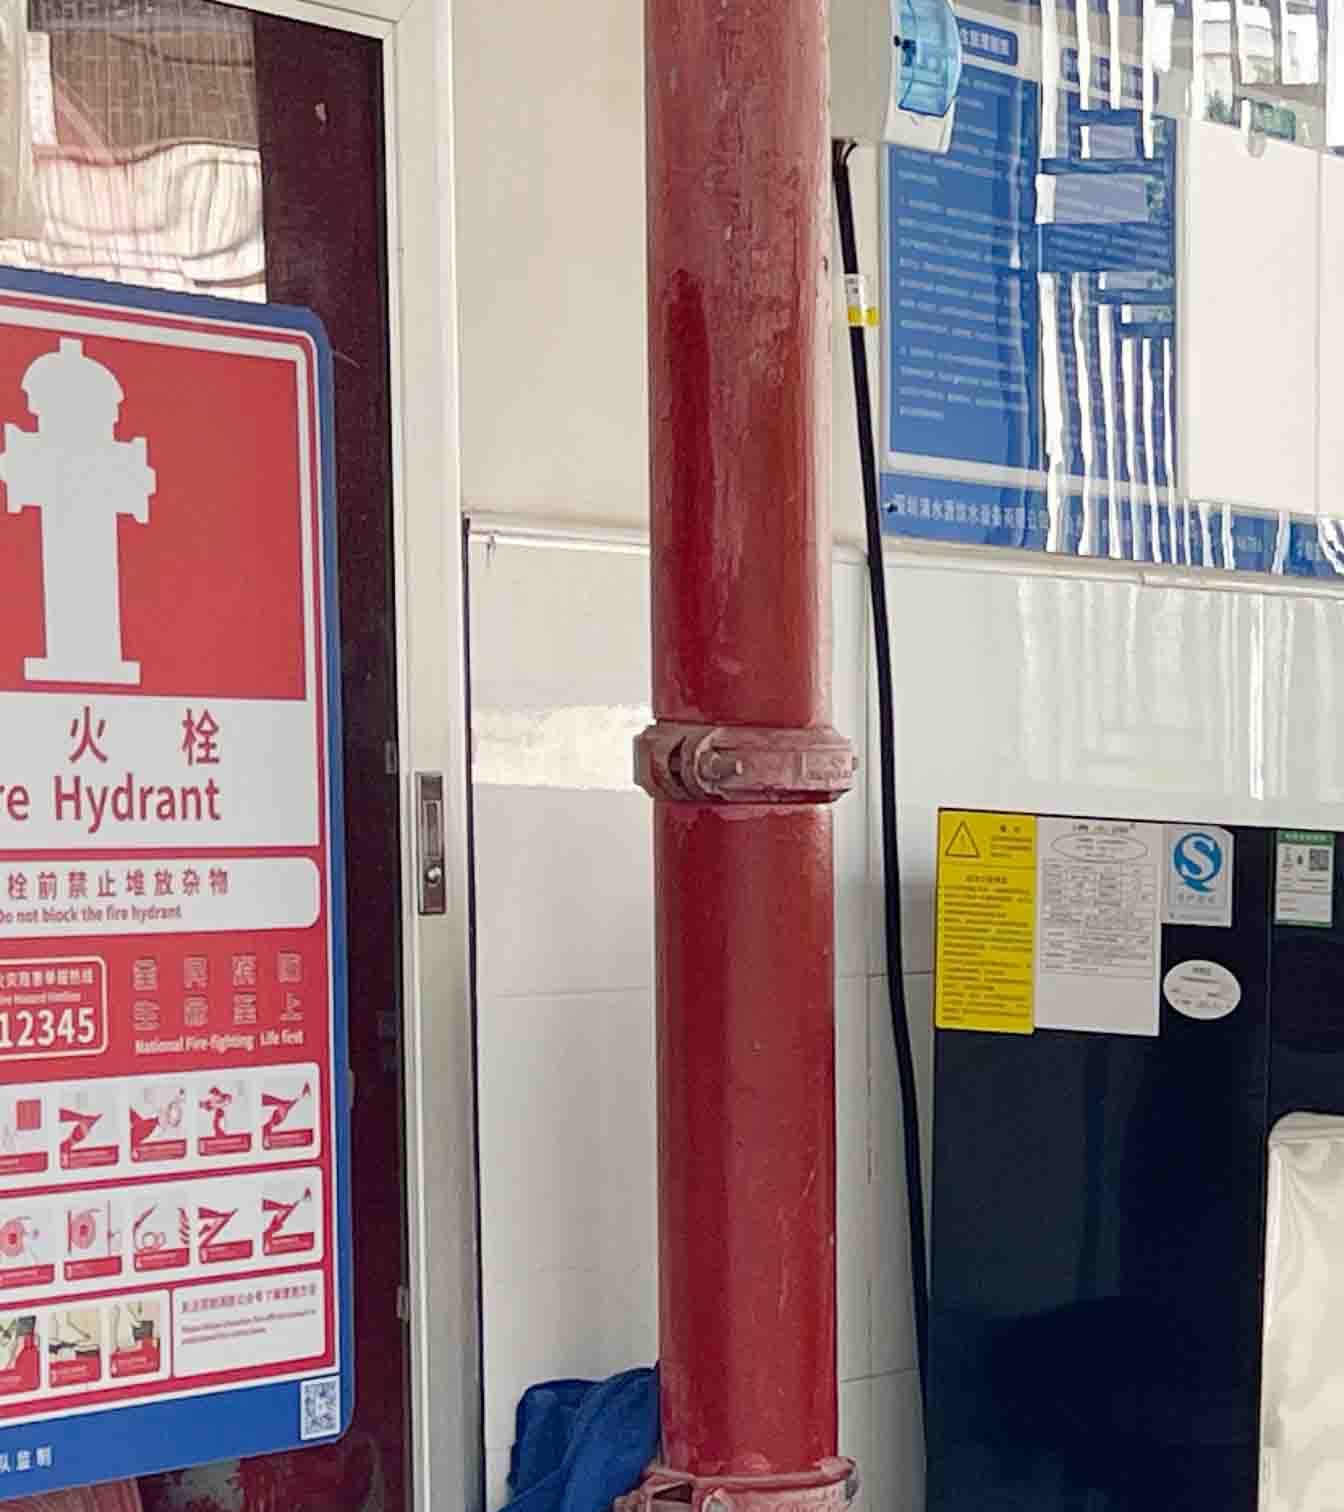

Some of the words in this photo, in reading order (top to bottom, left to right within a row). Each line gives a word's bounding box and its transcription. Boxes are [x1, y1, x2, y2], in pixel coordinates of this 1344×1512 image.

[54, 772, 221, 834] Hydrant
[7, 868, 229, 900] 栓前禁止堆放杂物
[16, 908, 39, 923] not
[42, 906, 78, 923] block
[81, 905, 103, 922] the
[106, 904, 129, 921] fire
[131, 903, 183, 925] hydrant
[0, 1007, 96, 1048] 12345
